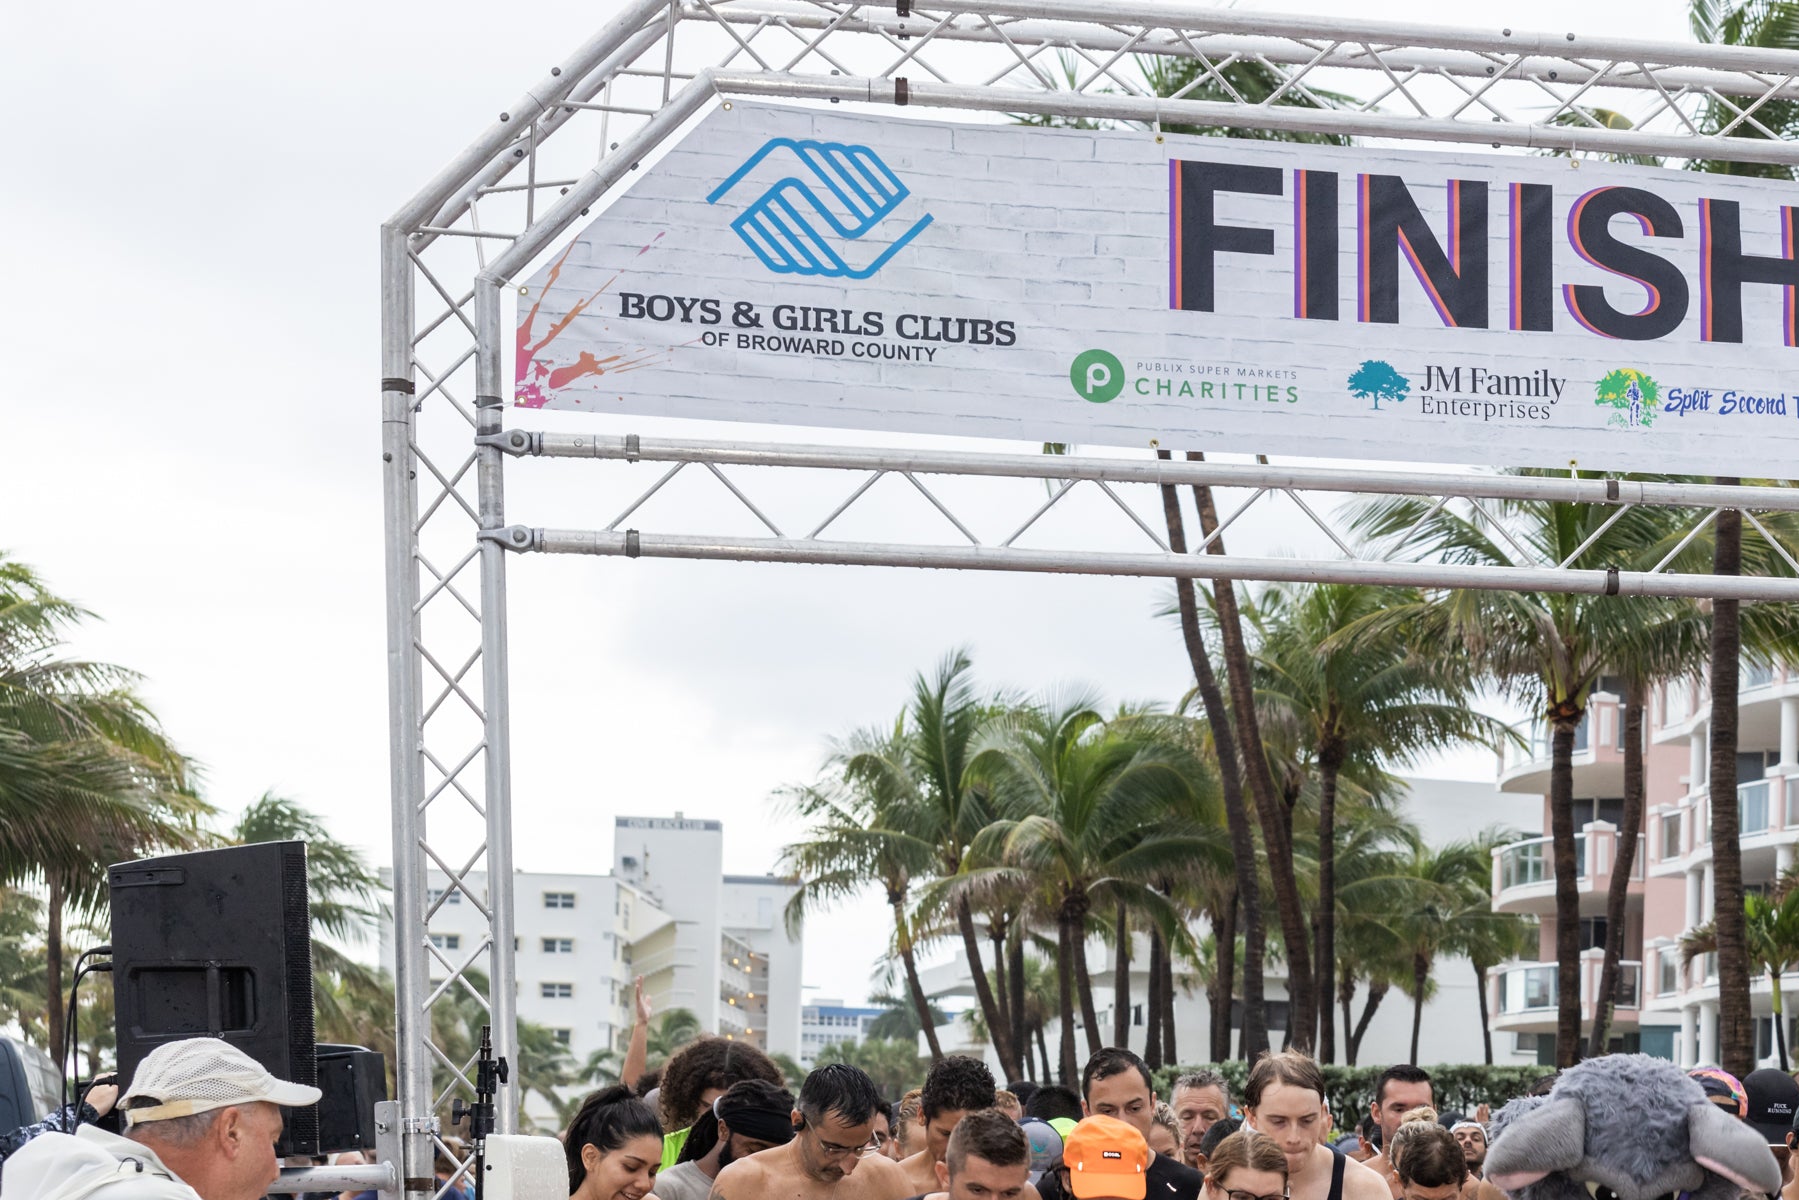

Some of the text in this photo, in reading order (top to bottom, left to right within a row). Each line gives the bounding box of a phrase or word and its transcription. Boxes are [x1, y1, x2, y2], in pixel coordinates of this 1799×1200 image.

[619, 292, 1016, 346] BOYS & GIRLS CLUBS
[702, 331, 937, 362] OF BROWARD COUNTY
[1136, 362, 1298, 381] PUBLIX SUPER MARKETS
[1420, 365, 1566, 404] JM Family
[1135, 378, 1299, 403] CHARITIES
[1664, 388, 1713, 415] Split
[1718, 392, 1787, 416] Second
[1421, 396, 1551, 422] Enterprises
